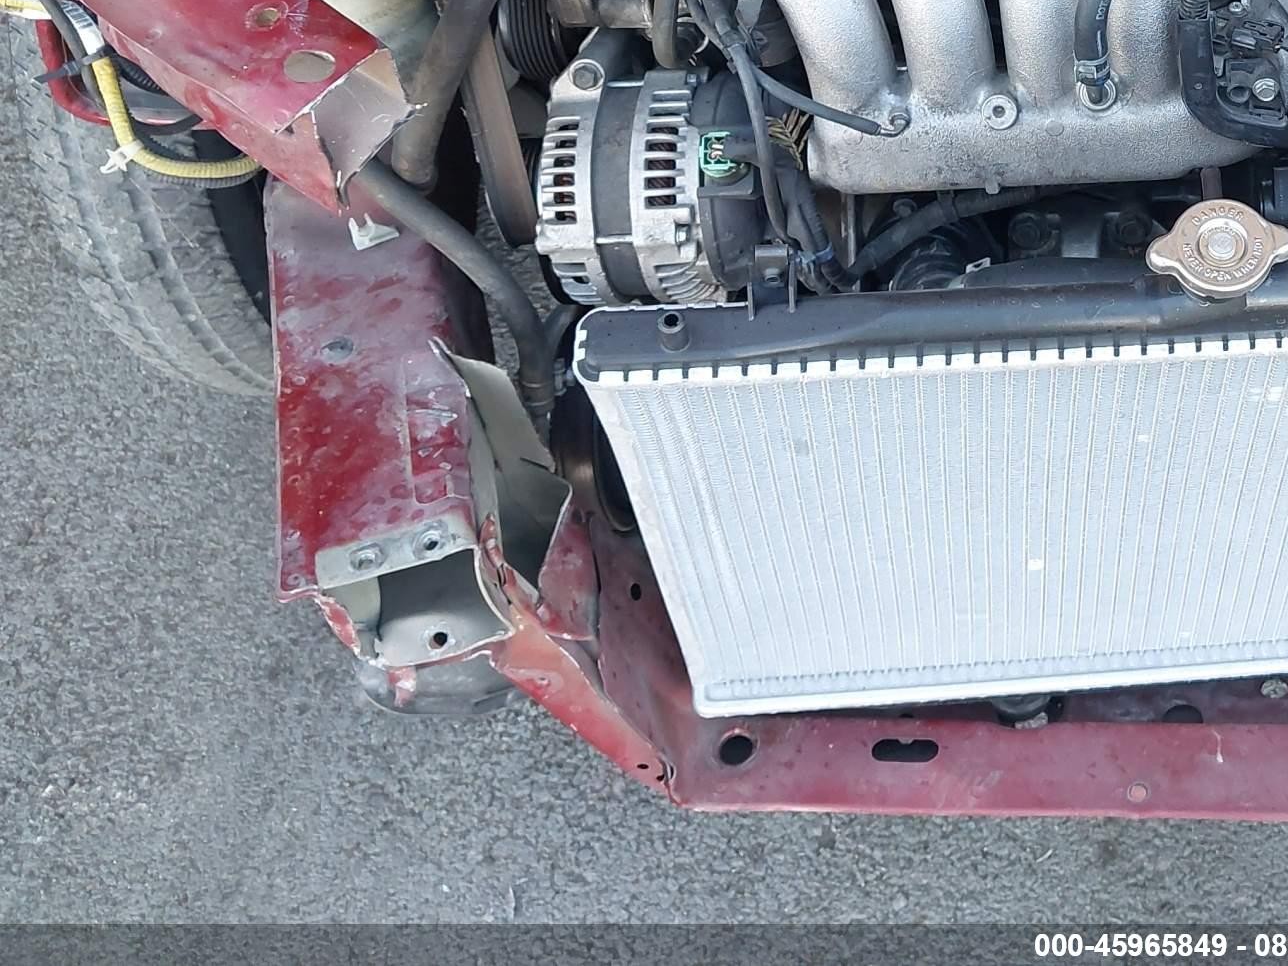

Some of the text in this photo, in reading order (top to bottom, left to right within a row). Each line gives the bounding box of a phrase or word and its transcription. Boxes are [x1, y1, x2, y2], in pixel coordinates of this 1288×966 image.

[1192, 207, 1244, 226] DANGER
[1183, 242, 1204, 273] NEVER
[1204, 268, 1232, 283] OPEN
